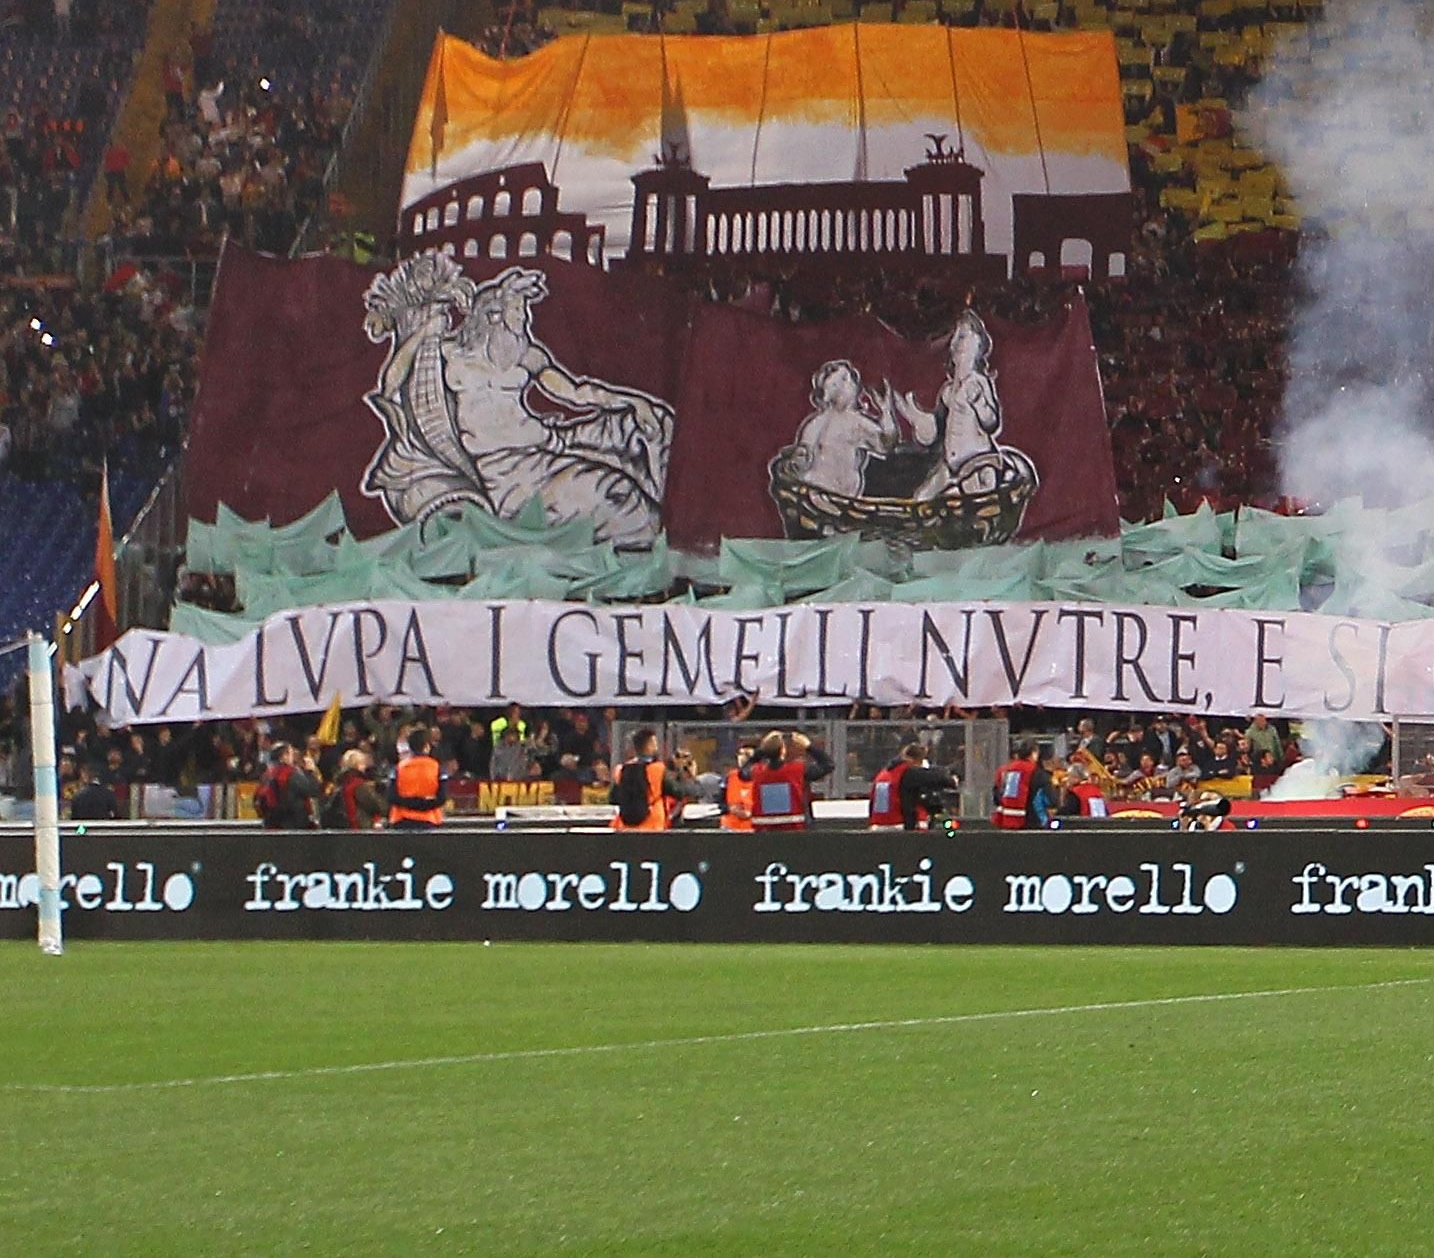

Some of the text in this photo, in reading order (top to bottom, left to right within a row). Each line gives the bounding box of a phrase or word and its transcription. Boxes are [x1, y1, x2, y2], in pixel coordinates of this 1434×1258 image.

[104, 638, 212, 718] NA
[255, 605, 446, 707] LVPA
[487, 605, 507, 700] I
[547, 608, 876, 700] GEMELLI
[1254, 618, 1287, 710] E
[1324, 621, 1395, 717] SI
[244, 858, 454, 911] frankie
[482, 862, 699, 912] morello
[752, 858, 975, 913] frankie
[1003, 863, 1238, 914] morello
